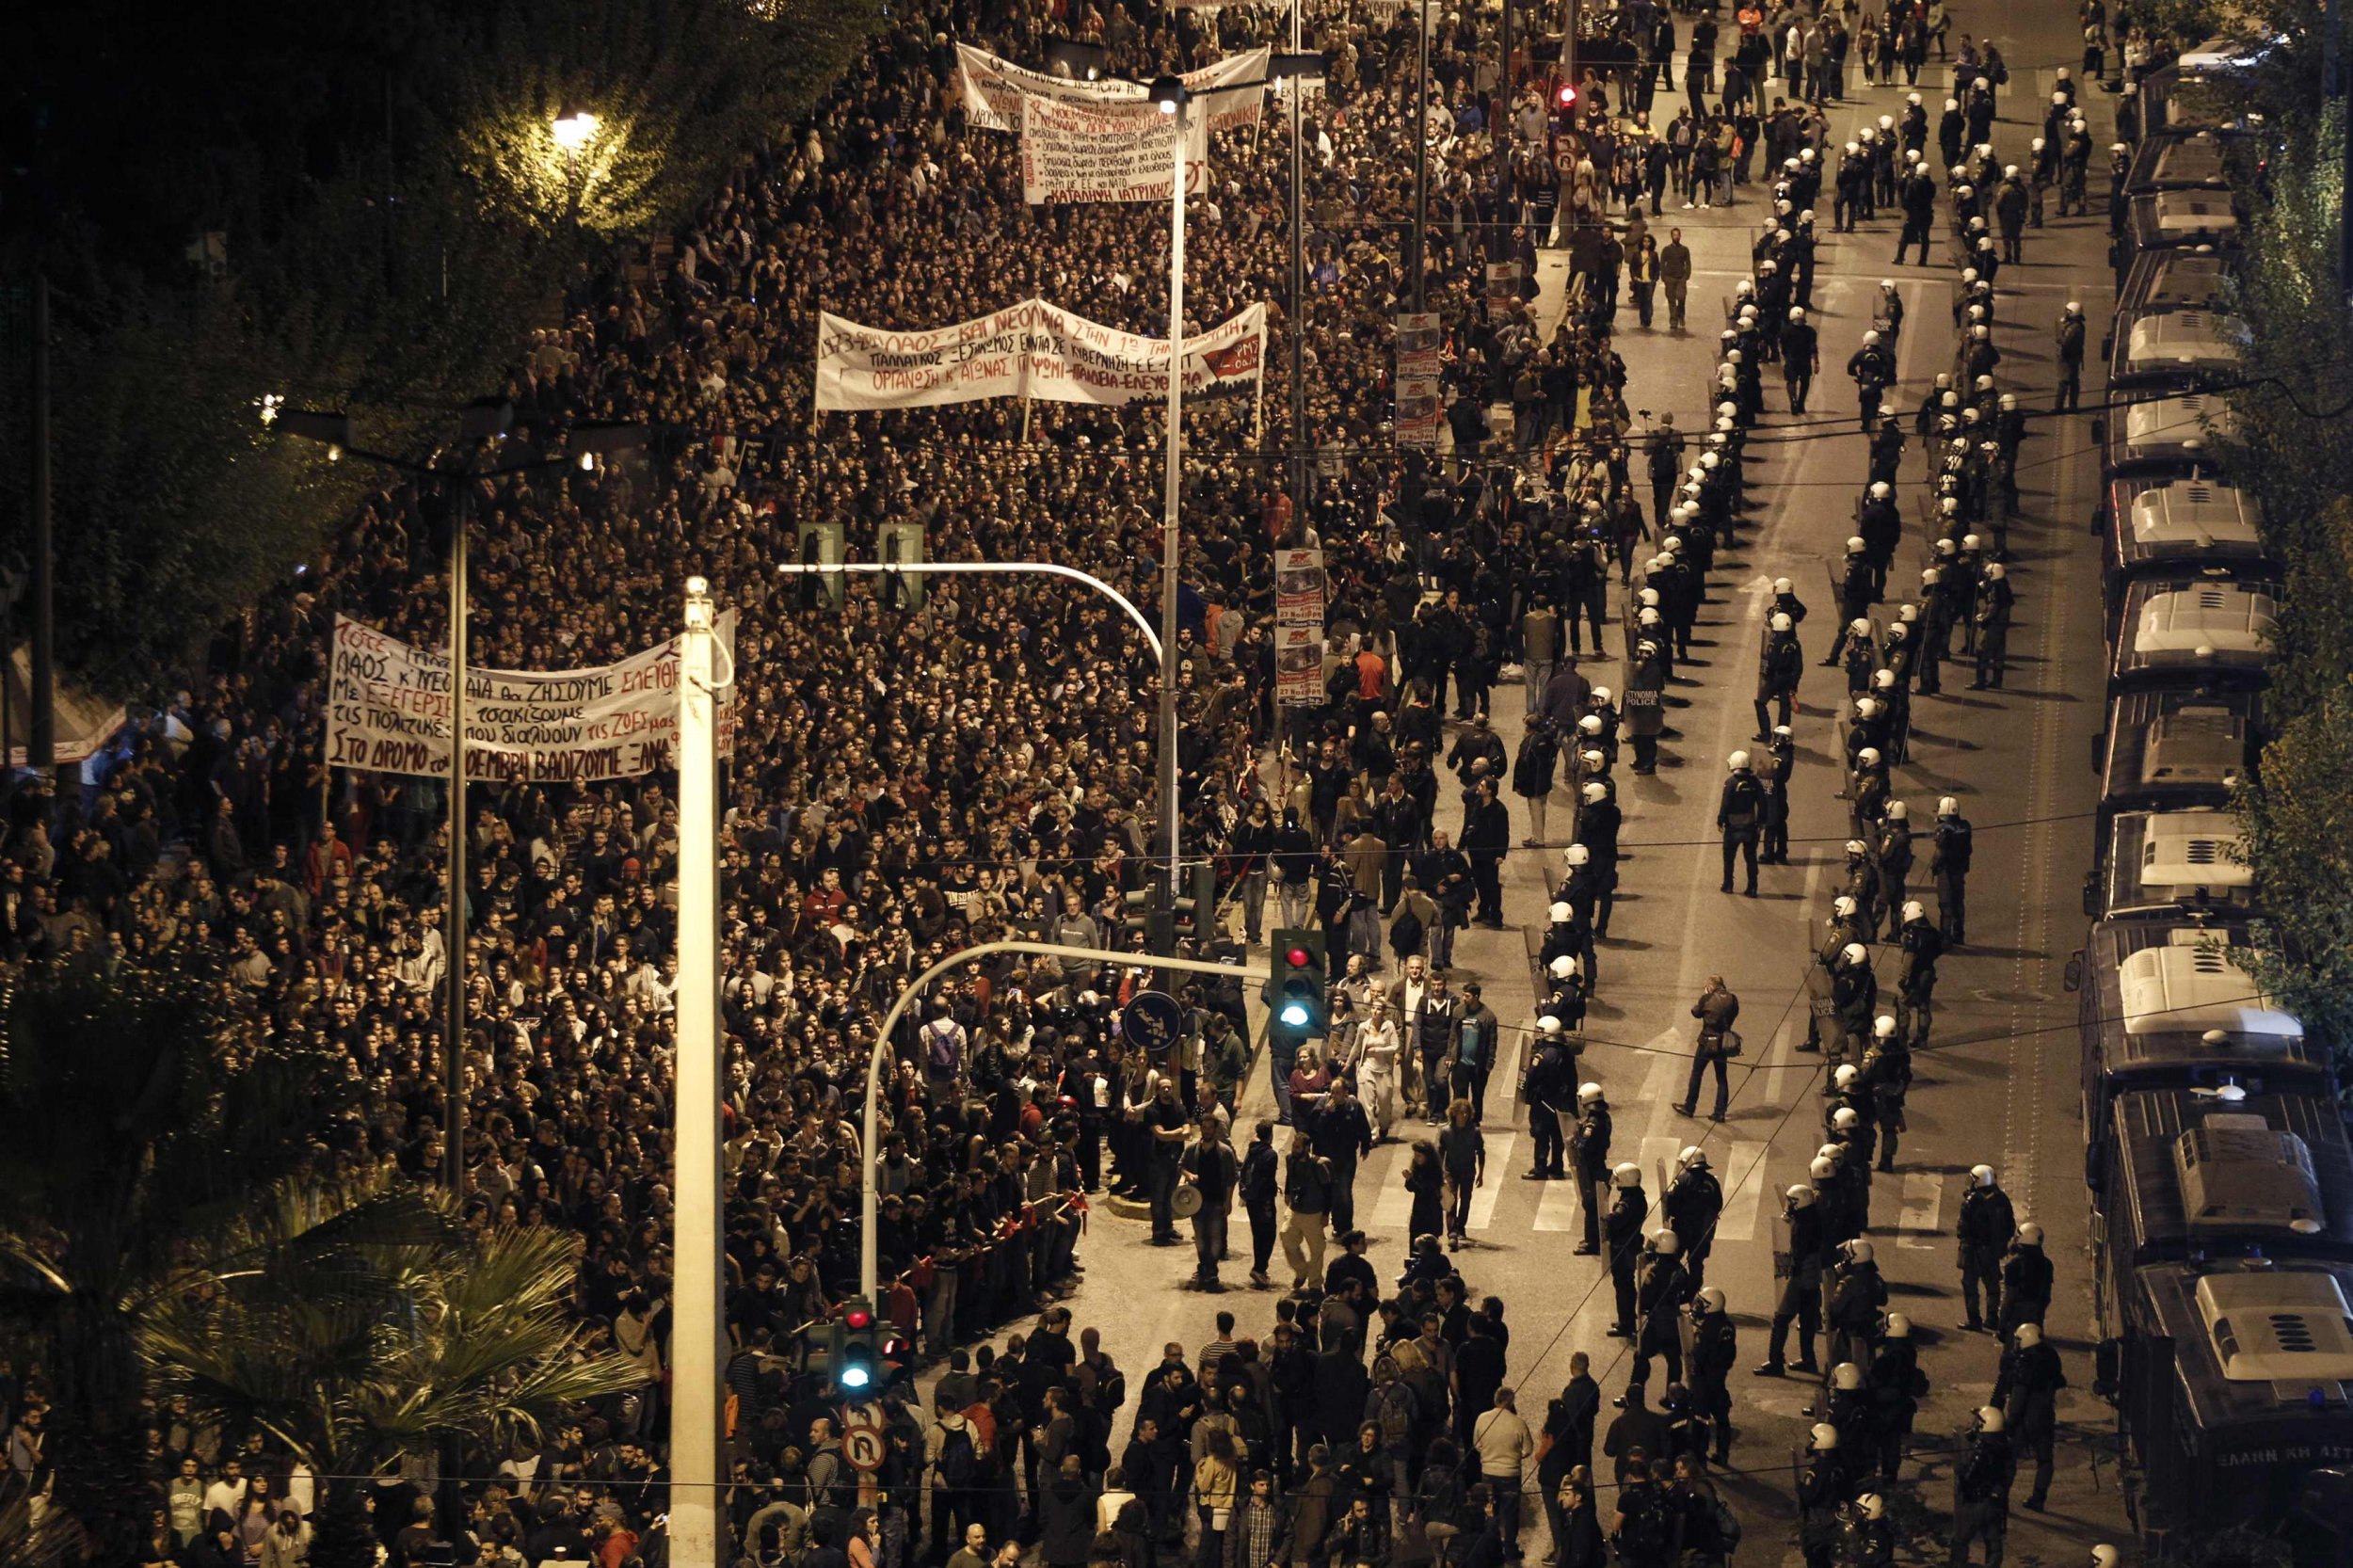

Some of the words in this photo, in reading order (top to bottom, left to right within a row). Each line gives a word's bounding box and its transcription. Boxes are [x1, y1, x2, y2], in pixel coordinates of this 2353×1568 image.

[1050, 188, 1113, 202] ΚΑΤΑΛΗΨΗ
[1118, 182, 1171, 200] ΙΑΤΡΙΚΗΣ
[1109, 177, 1128, 189] ΝΑΤΟ
[886, 330, 947, 353] ΛΑΟΣ
[958, 324, 986, 342] ΚΑΙ
[1072, 321, 1110, 347] ΣΤΗΝ
[873, 369, 939, 391] ΟΡΓΑΝΩΣΗ
[960, 357, 1011, 380] ΑΓΩΝΑΣ
[336, 650, 390, 682] ΛΑΟΣ
[417, 669, 493, 698] ΝΕΟΑΙΑ
[501, 685, 521, 701] θα
[526, 675, 614, 702] ΖΗΣΟΥΜΕ
[332, 678, 360, 702] Με
[477, 705, 585, 728] τσακίζουμε
[333, 705, 361, 725] τις
[466, 727, 496, 742] που
[503, 722, 583, 746] διαλύουν
[586, 722, 609, 742] τις
[610, 710, 649, 738] ΖΩΕΣ
[649, 715, 676, 733] μας
[329, 728, 368, 764] ΣΤΟ
[371, 739, 429, 774] ΔΡΟΜΟ
[466, 748, 529, 780] ΟΕΜΒΡΗ
[535, 744, 622, 781] ΒΑΔΙΖΟΥΜΕ
